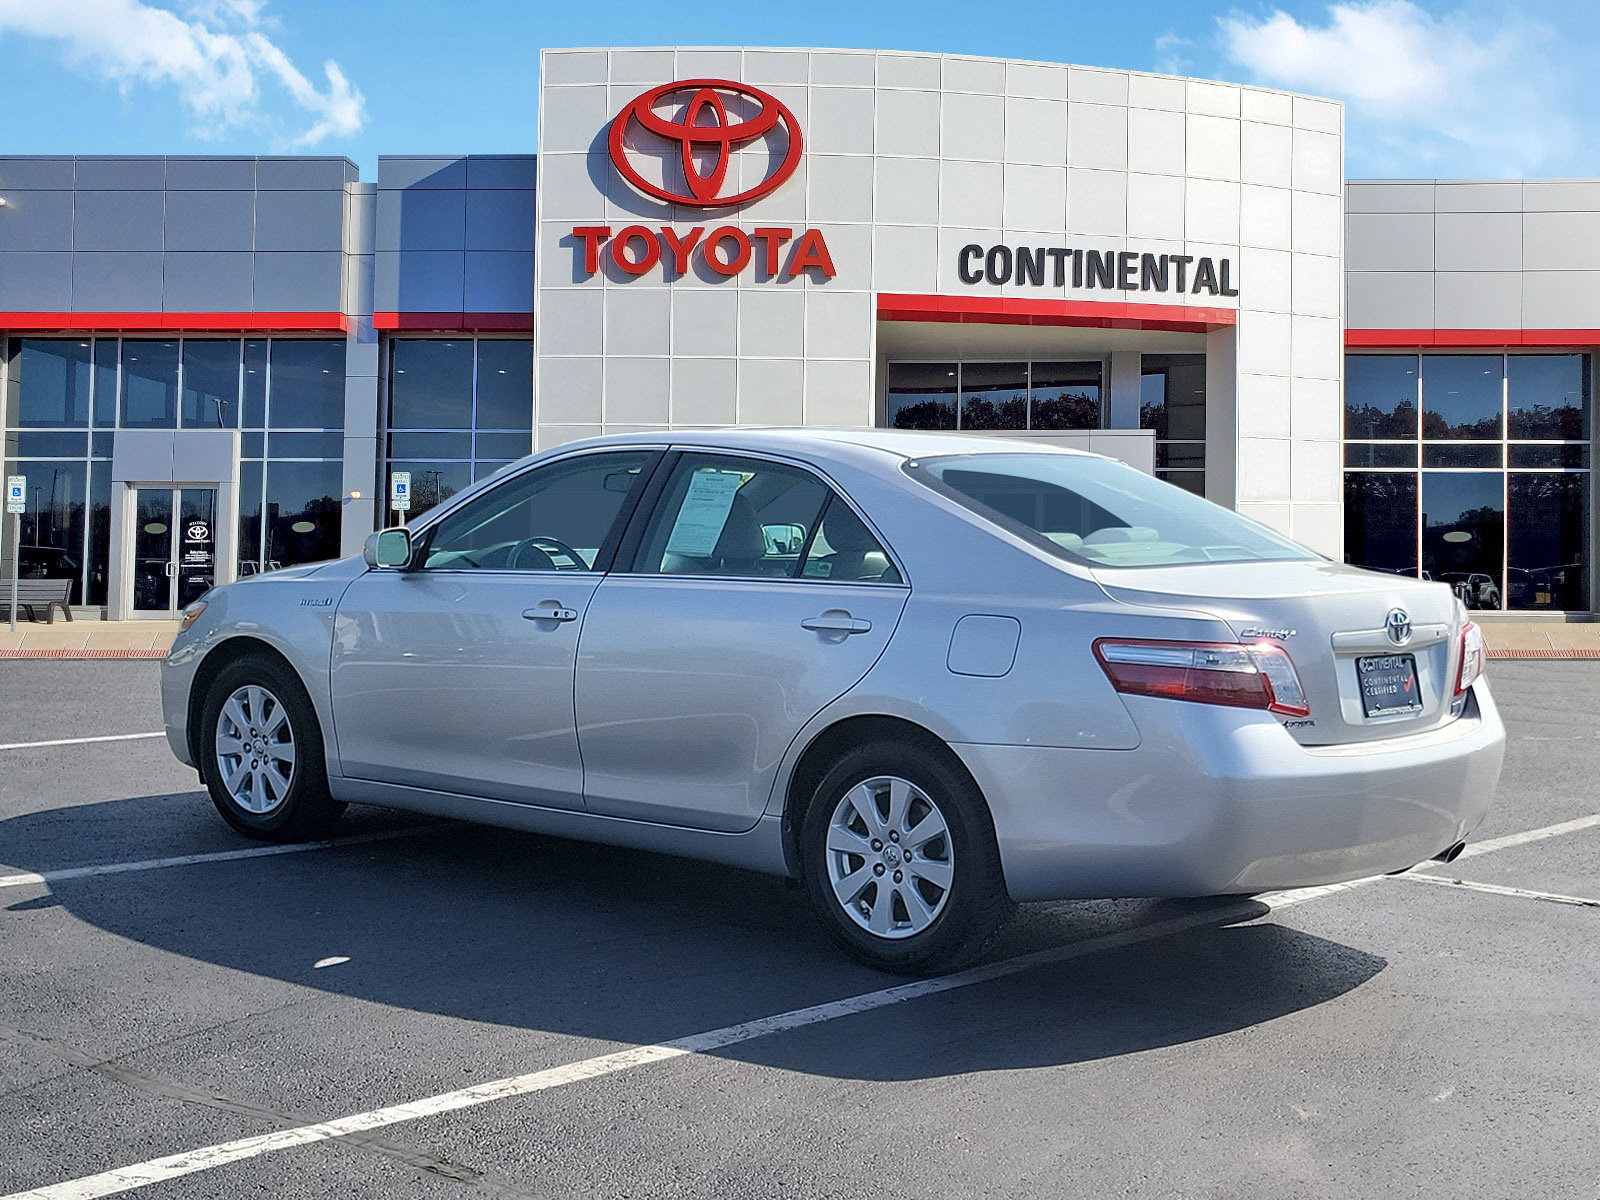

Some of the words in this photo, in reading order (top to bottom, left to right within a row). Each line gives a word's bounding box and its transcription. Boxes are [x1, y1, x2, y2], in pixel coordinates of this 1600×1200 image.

[572, 225, 837, 277] TOYOTA
[958, 244, 1239, 297] CONTINENTAL
[1363, 674, 1408, 688] CONTINENTAL
[1365, 684, 1398, 697] CERTIFIED
